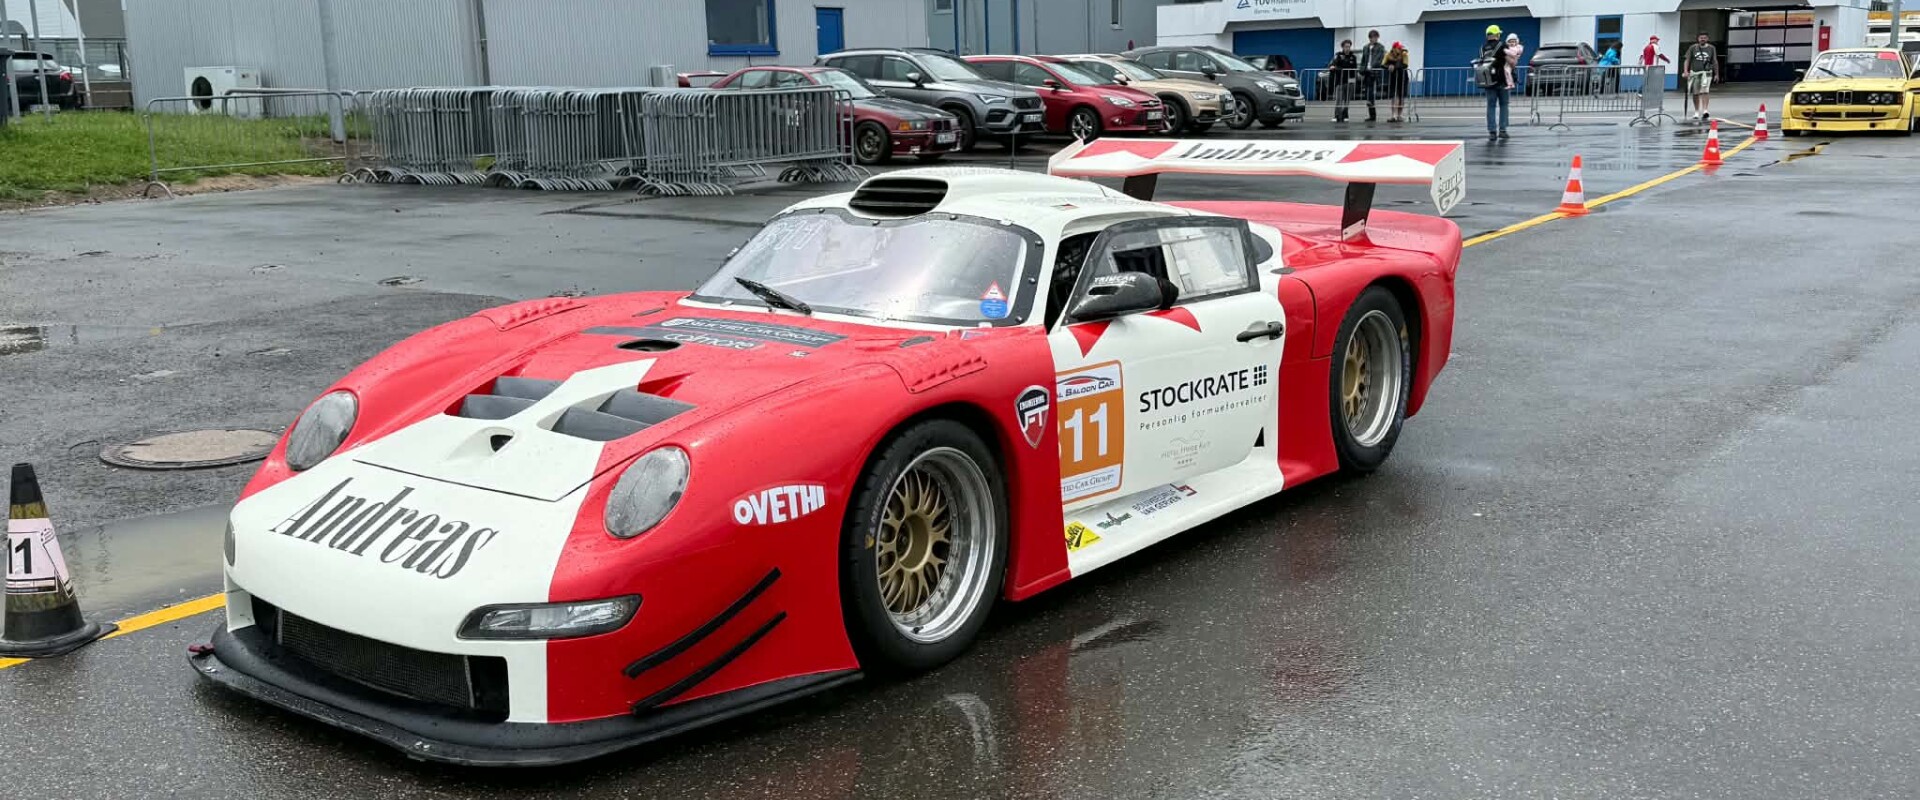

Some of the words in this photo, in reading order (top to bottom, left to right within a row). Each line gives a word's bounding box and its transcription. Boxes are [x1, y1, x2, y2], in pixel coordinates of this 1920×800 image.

[1177, 142, 1334, 161] Andreas
[1066, 384, 1097, 397] SALOON
[1098, 380, 1115, 390] CAR
[1139, 369, 1249, 413] STOCKRATE
[1058, 402, 1108, 463] 11
[1139, 414, 1187, 431] Personlig
[734, 484, 826, 525] OVETHI
[268, 482, 500, 580] Andreas
